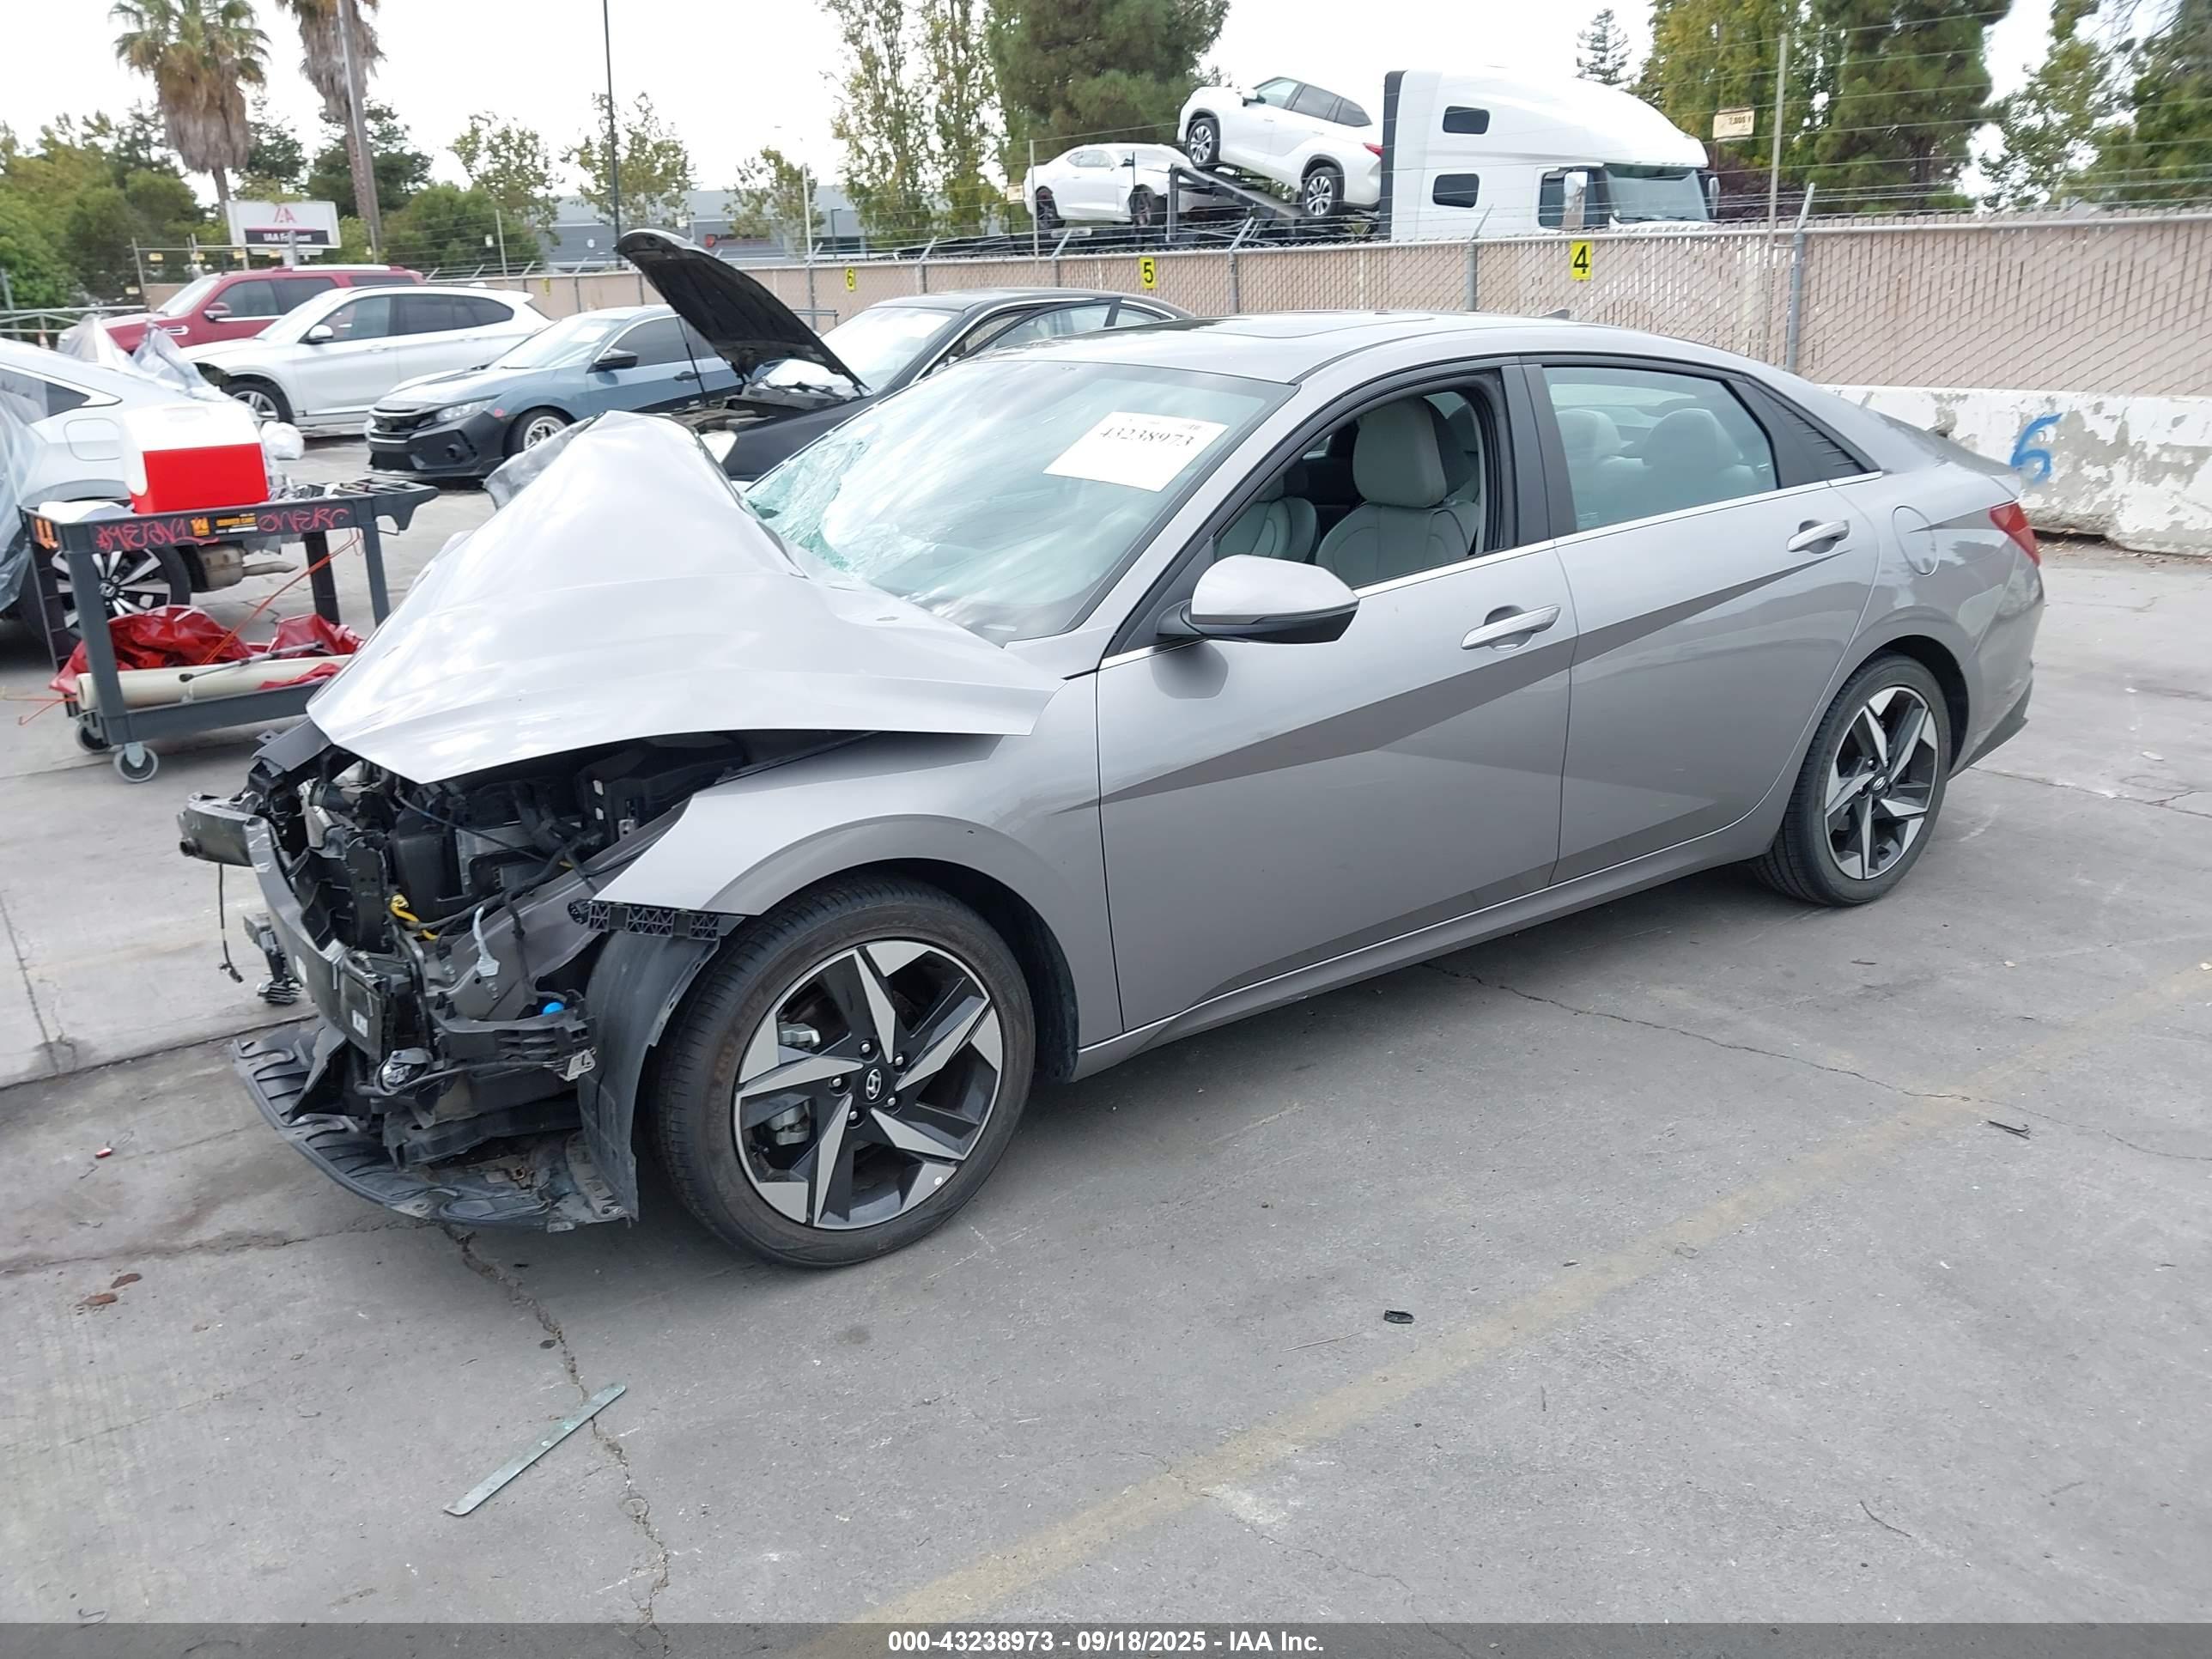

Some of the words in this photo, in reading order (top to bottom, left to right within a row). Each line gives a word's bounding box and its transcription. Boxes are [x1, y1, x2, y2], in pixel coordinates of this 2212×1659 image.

[1143, 261, 1154, 283] 5
[1573, 245, 1589, 274] 4
[847, 269, 854, 287] 6
[2010, 413, 2063, 484] 6
